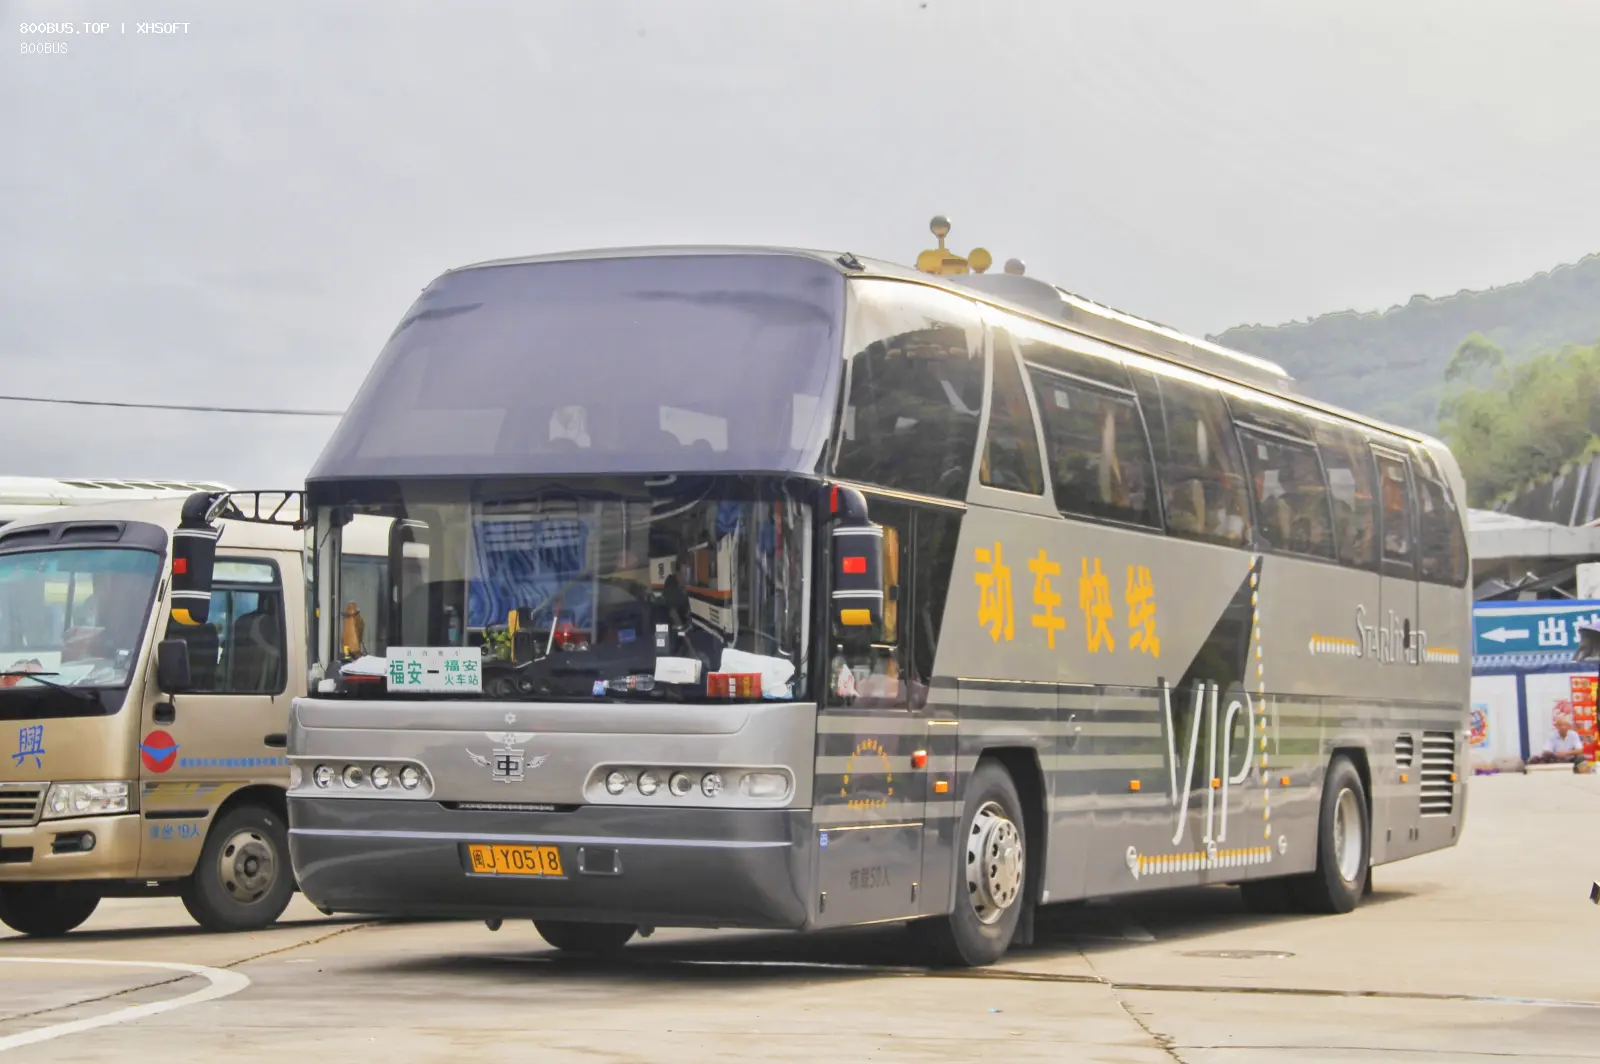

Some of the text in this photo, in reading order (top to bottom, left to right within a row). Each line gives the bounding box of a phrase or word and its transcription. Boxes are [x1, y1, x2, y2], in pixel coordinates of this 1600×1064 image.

[974, 541, 1160, 659] 动车快线
[389, 660, 422, 685] 福安
[444, 660, 478, 672] 福安
[444, 673, 479, 686] 火车站
[11, 724, 46, 769] 興
[1163, 681, 1255, 846] VIP
